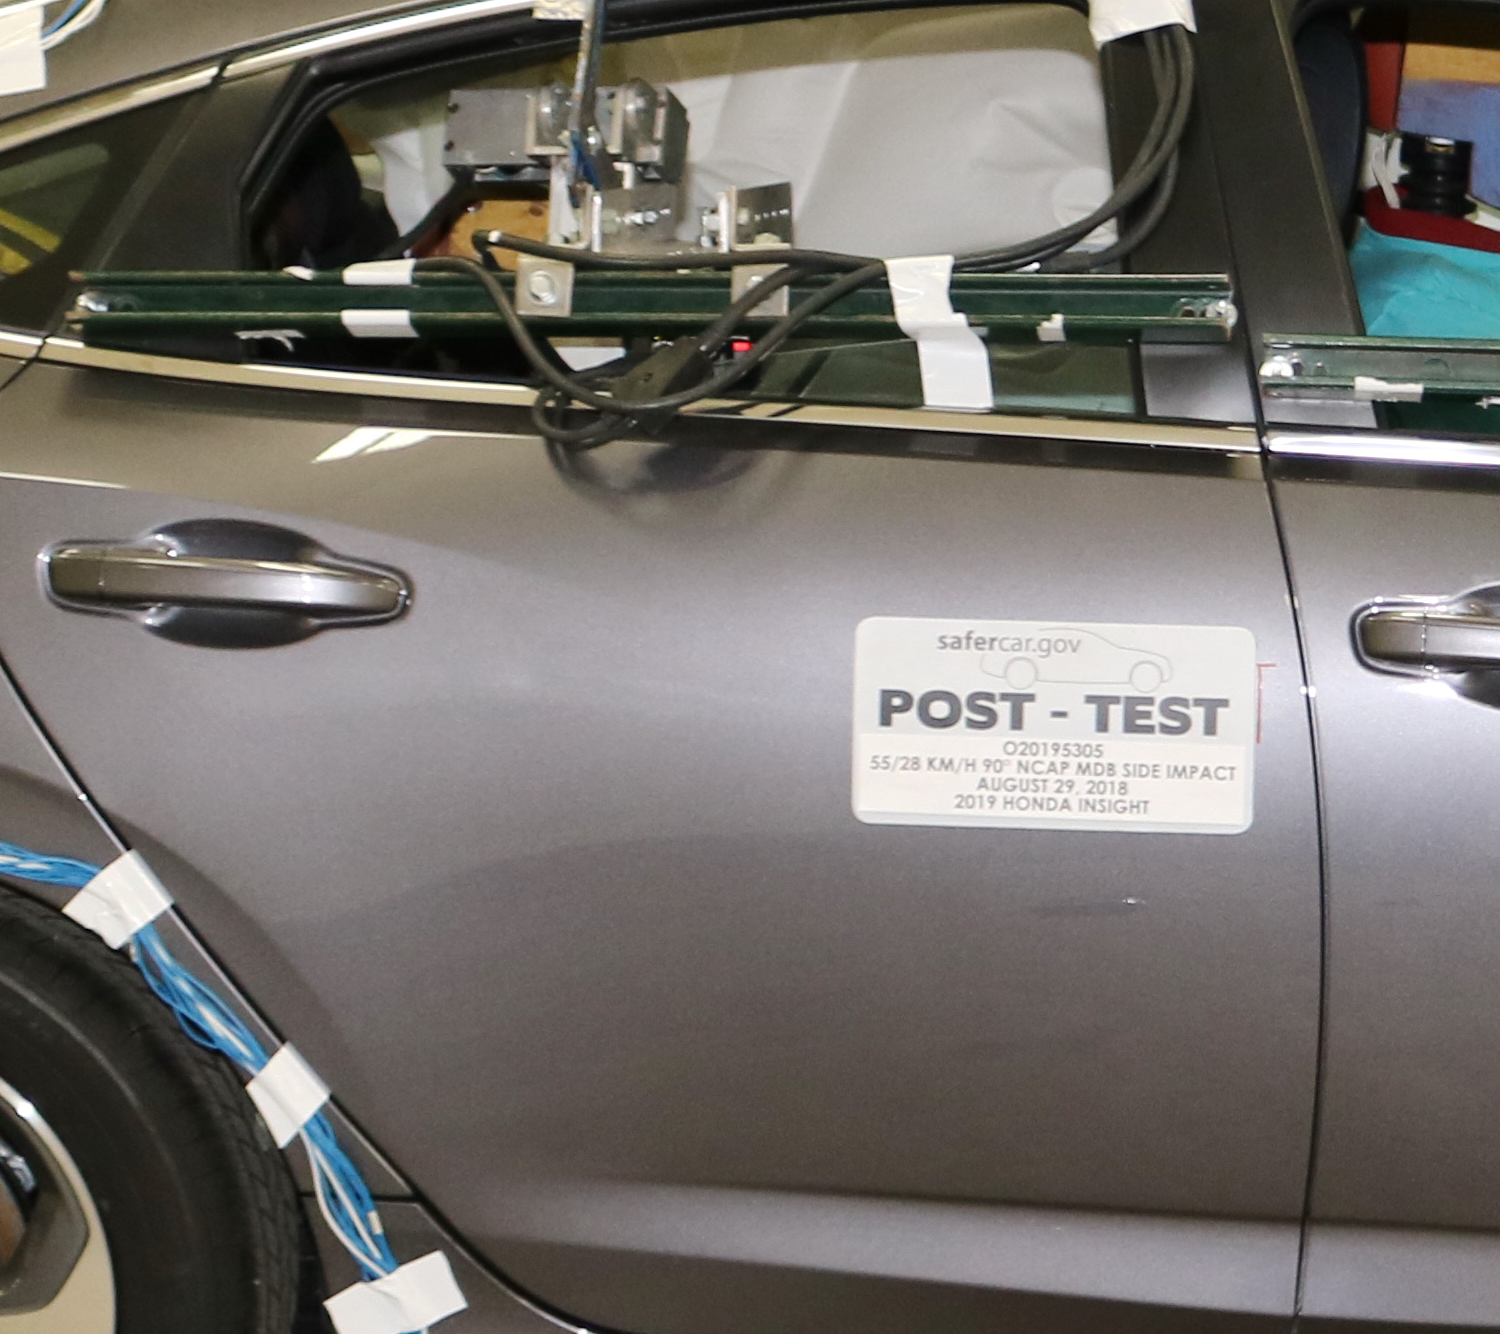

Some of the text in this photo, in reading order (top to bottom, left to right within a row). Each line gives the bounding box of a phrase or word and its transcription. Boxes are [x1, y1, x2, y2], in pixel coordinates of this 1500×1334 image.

[937, 630, 1082, 659] safercar.gov
[878, 688, 1230, 736] POST - TEST
[869, 755, 921, 771] 55/28
[927, 757, 977, 774] KM/H
[1016, 760, 1070, 776] NCAP
[1075, 762, 1117, 777] MDB
[1121, 763, 1162, 779] SIDE
[1166, 765, 1236, 781] IMPACT
[976, 777, 1128, 796] AUGUST 29, 2018
[954, 794, 1149, 814] 2019 HONDA INSIGHT
